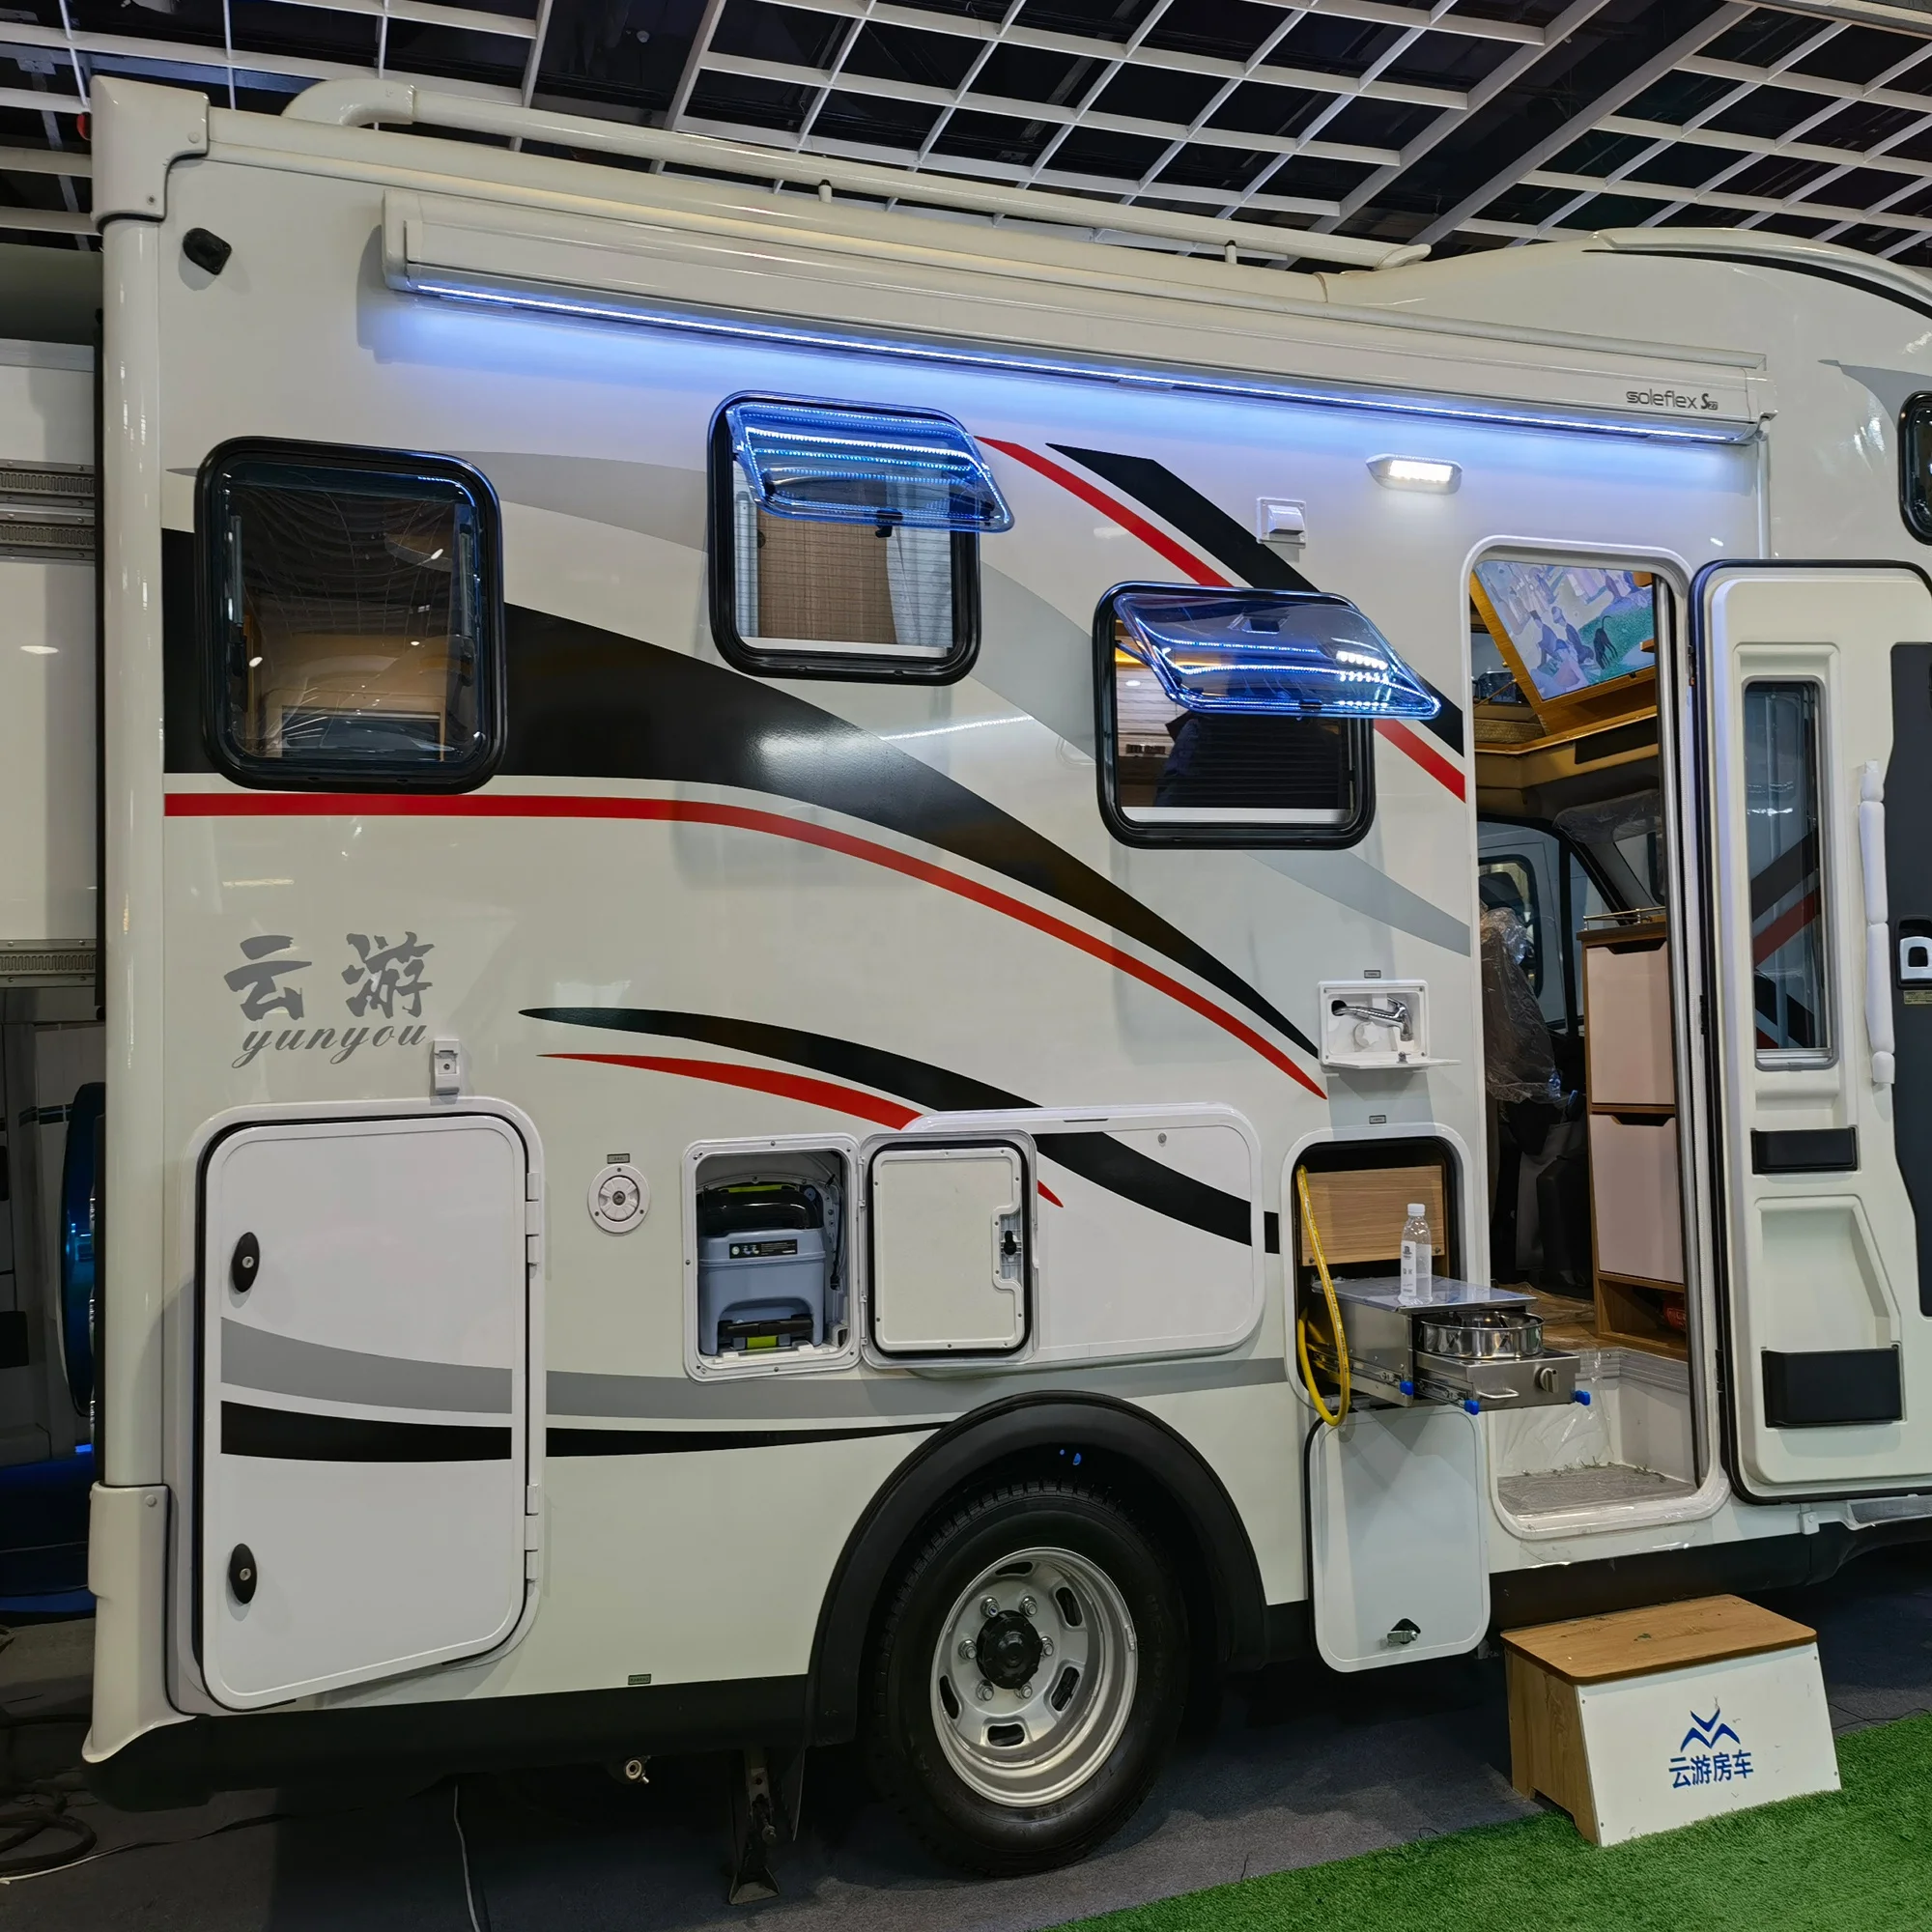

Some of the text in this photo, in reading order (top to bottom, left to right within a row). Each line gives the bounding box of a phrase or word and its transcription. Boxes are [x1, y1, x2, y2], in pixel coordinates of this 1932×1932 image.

[1626, 388, 1698, 410] soleflex
[224, 931, 435, 1021] 云游
[231, 1025, 427, 1068] yunyou
[1668, 1749, 1753, 1788] 云游房车
